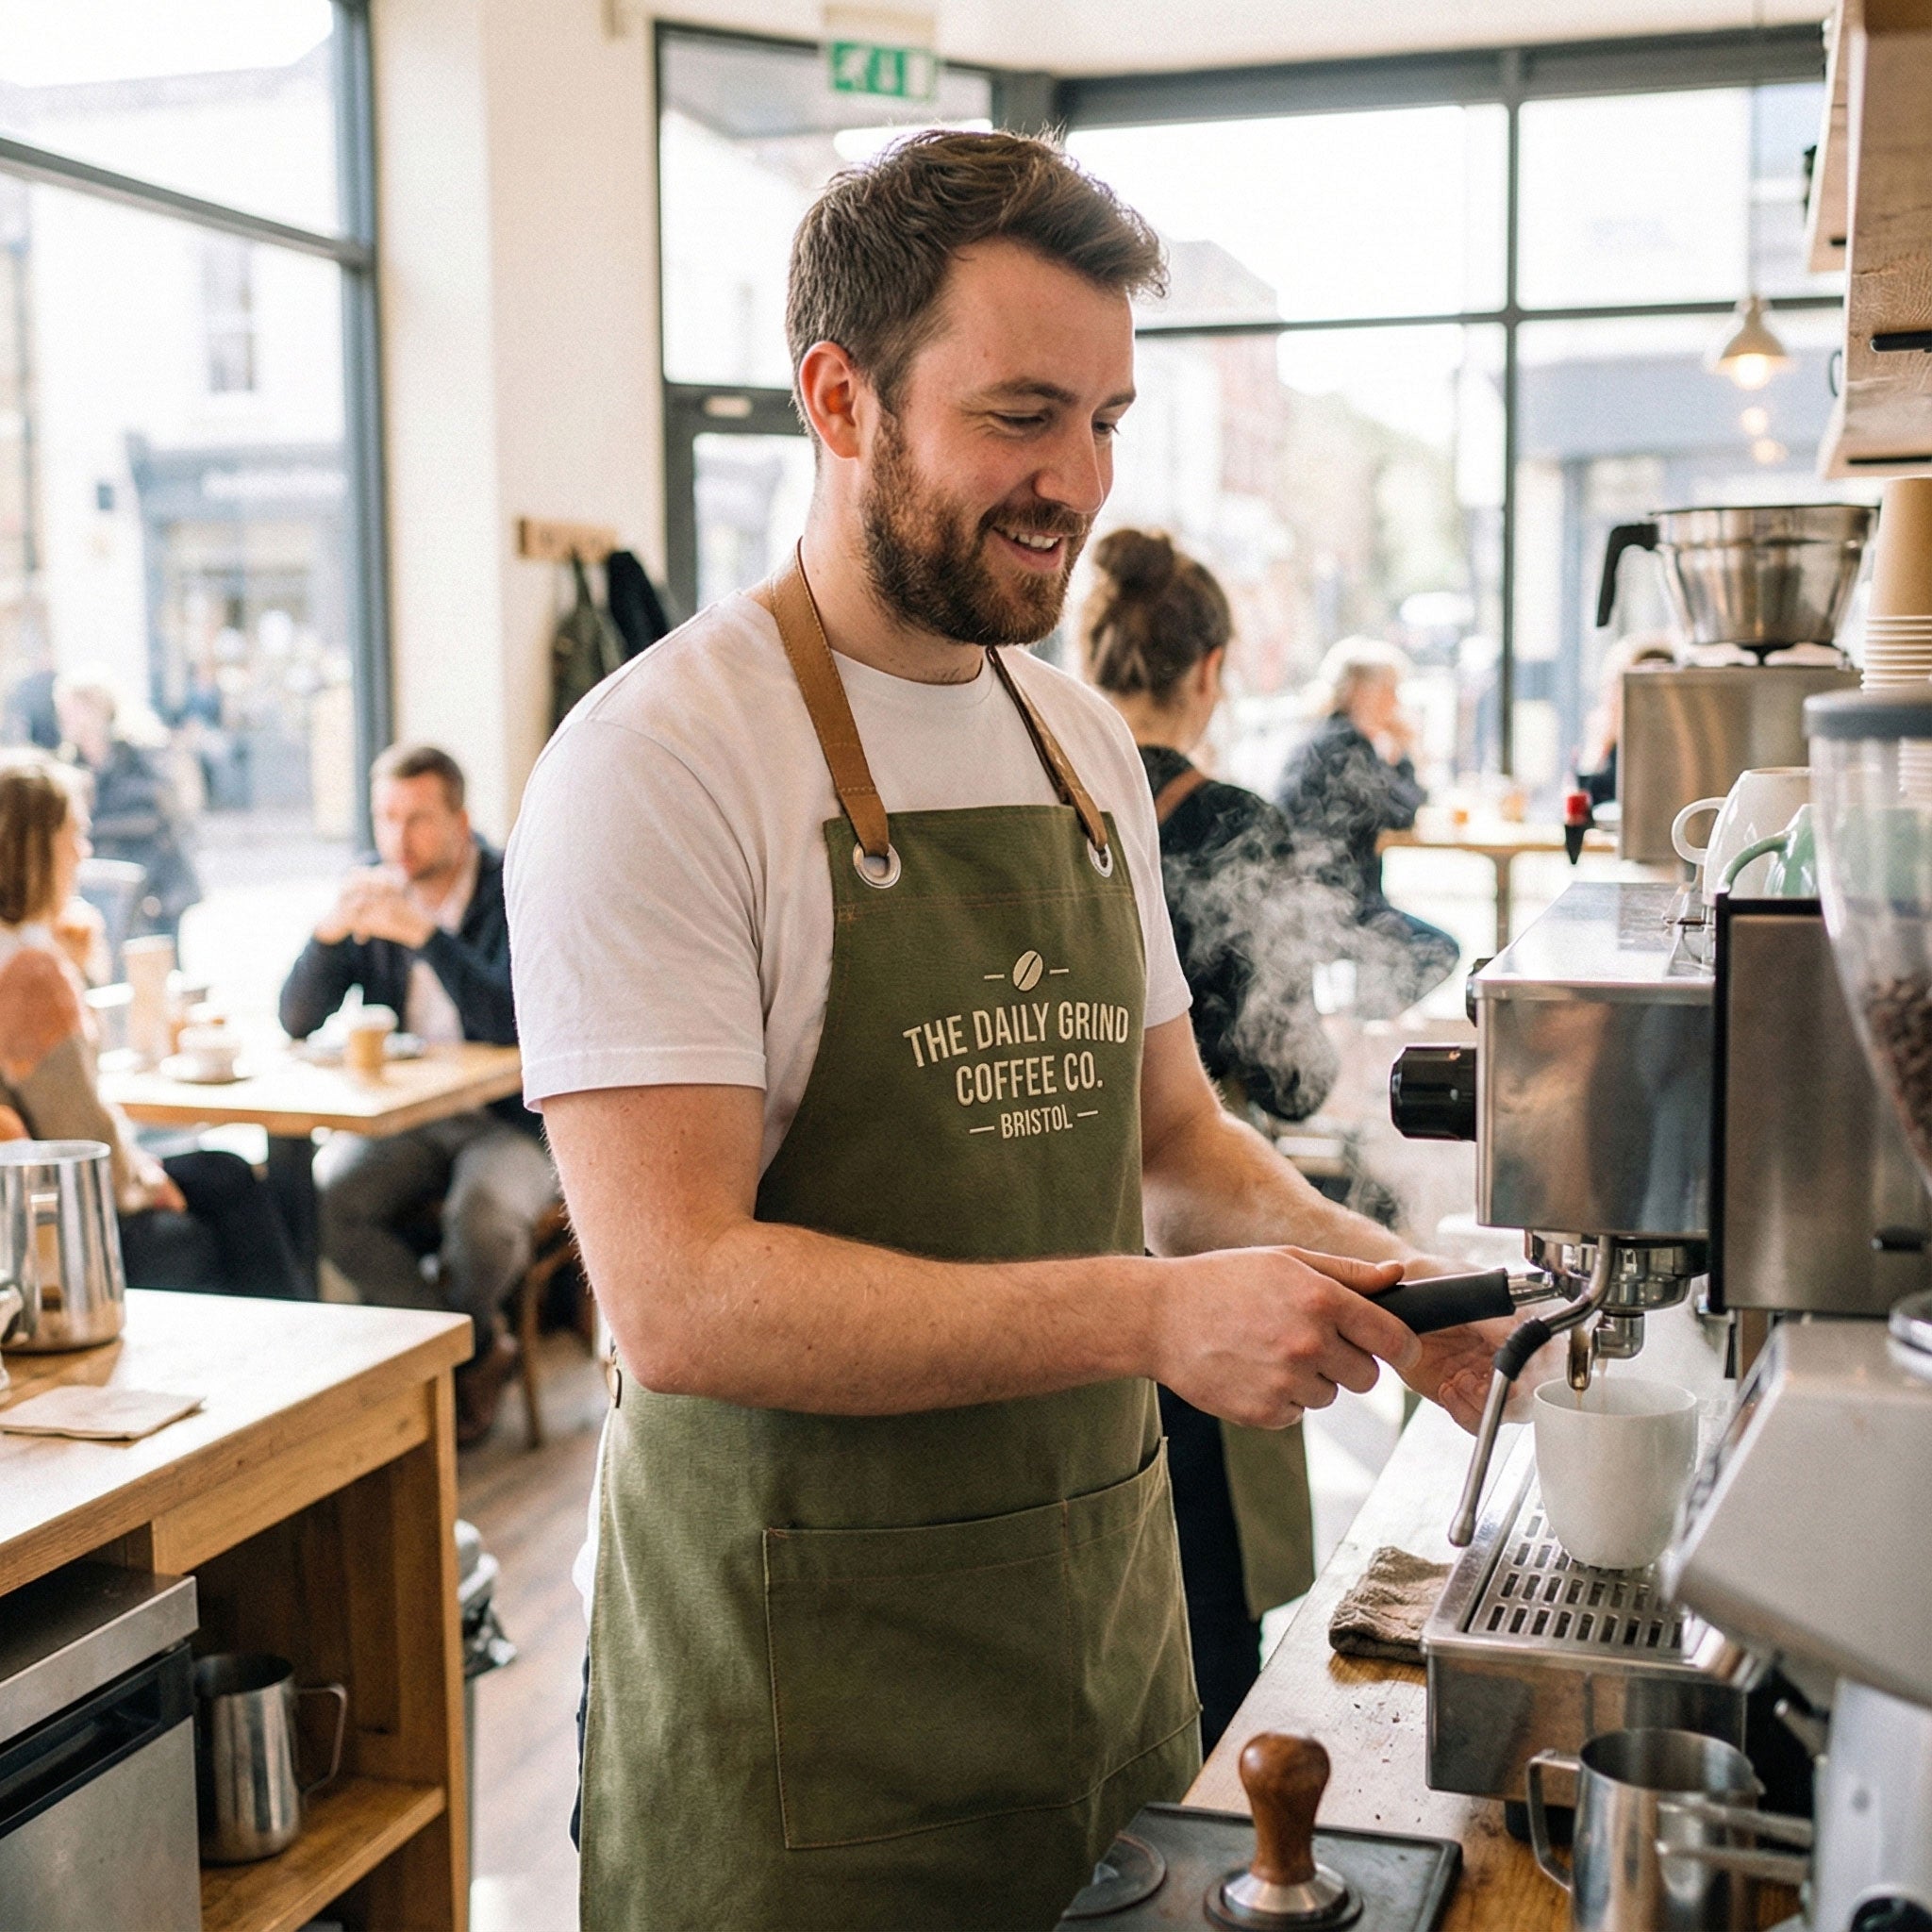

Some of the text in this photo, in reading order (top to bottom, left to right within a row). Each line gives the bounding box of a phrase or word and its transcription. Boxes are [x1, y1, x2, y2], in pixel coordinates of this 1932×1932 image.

[903, 1001, 1129, 1068] THE DAILY GRIND
[956, 1051, 1103, 1107] COFFEE CO.
[1000, 1104, 1073, 1139] BRISTOL
